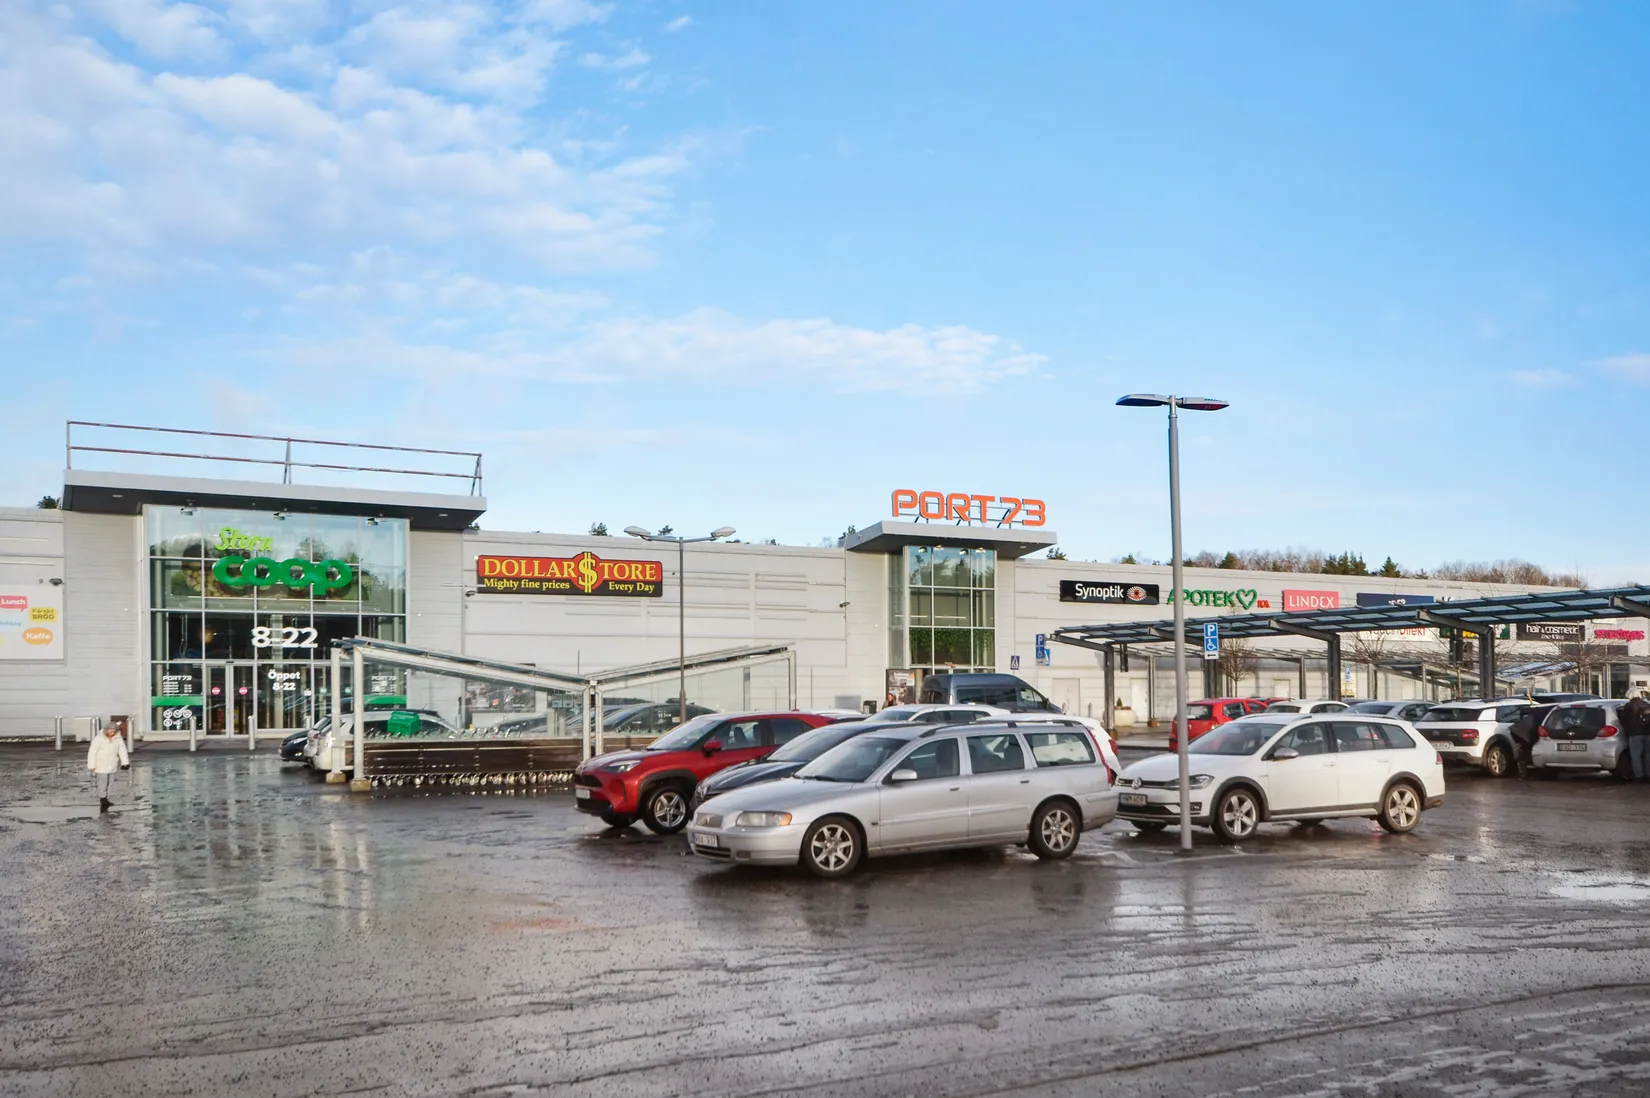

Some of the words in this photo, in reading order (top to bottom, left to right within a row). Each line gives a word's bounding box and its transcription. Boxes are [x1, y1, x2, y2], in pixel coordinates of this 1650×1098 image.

[892, 489, 996, 523] PORT
[1000, 497, 1047, 527] 73
[214, 526, 274, 551] Stora
[212, 556, 353, 596] coop
[484, 578, 520, 590] Mighty
[521, 578, 541, 589] fine
[542, 581, 570, 592] prices
[608, 582, 634, 594] Every
[636, 583, 655, 594] Day
[1075, 583, 1124, 600] Synoptik
[1289, 594, 1335, 609] LINDEX
[251, 626, 318, 648] 8-22
[1207, 624, 1215, 636] P
[268, 669, 301, 681] Öppet
[272, 682, 296, 691] 8-22
